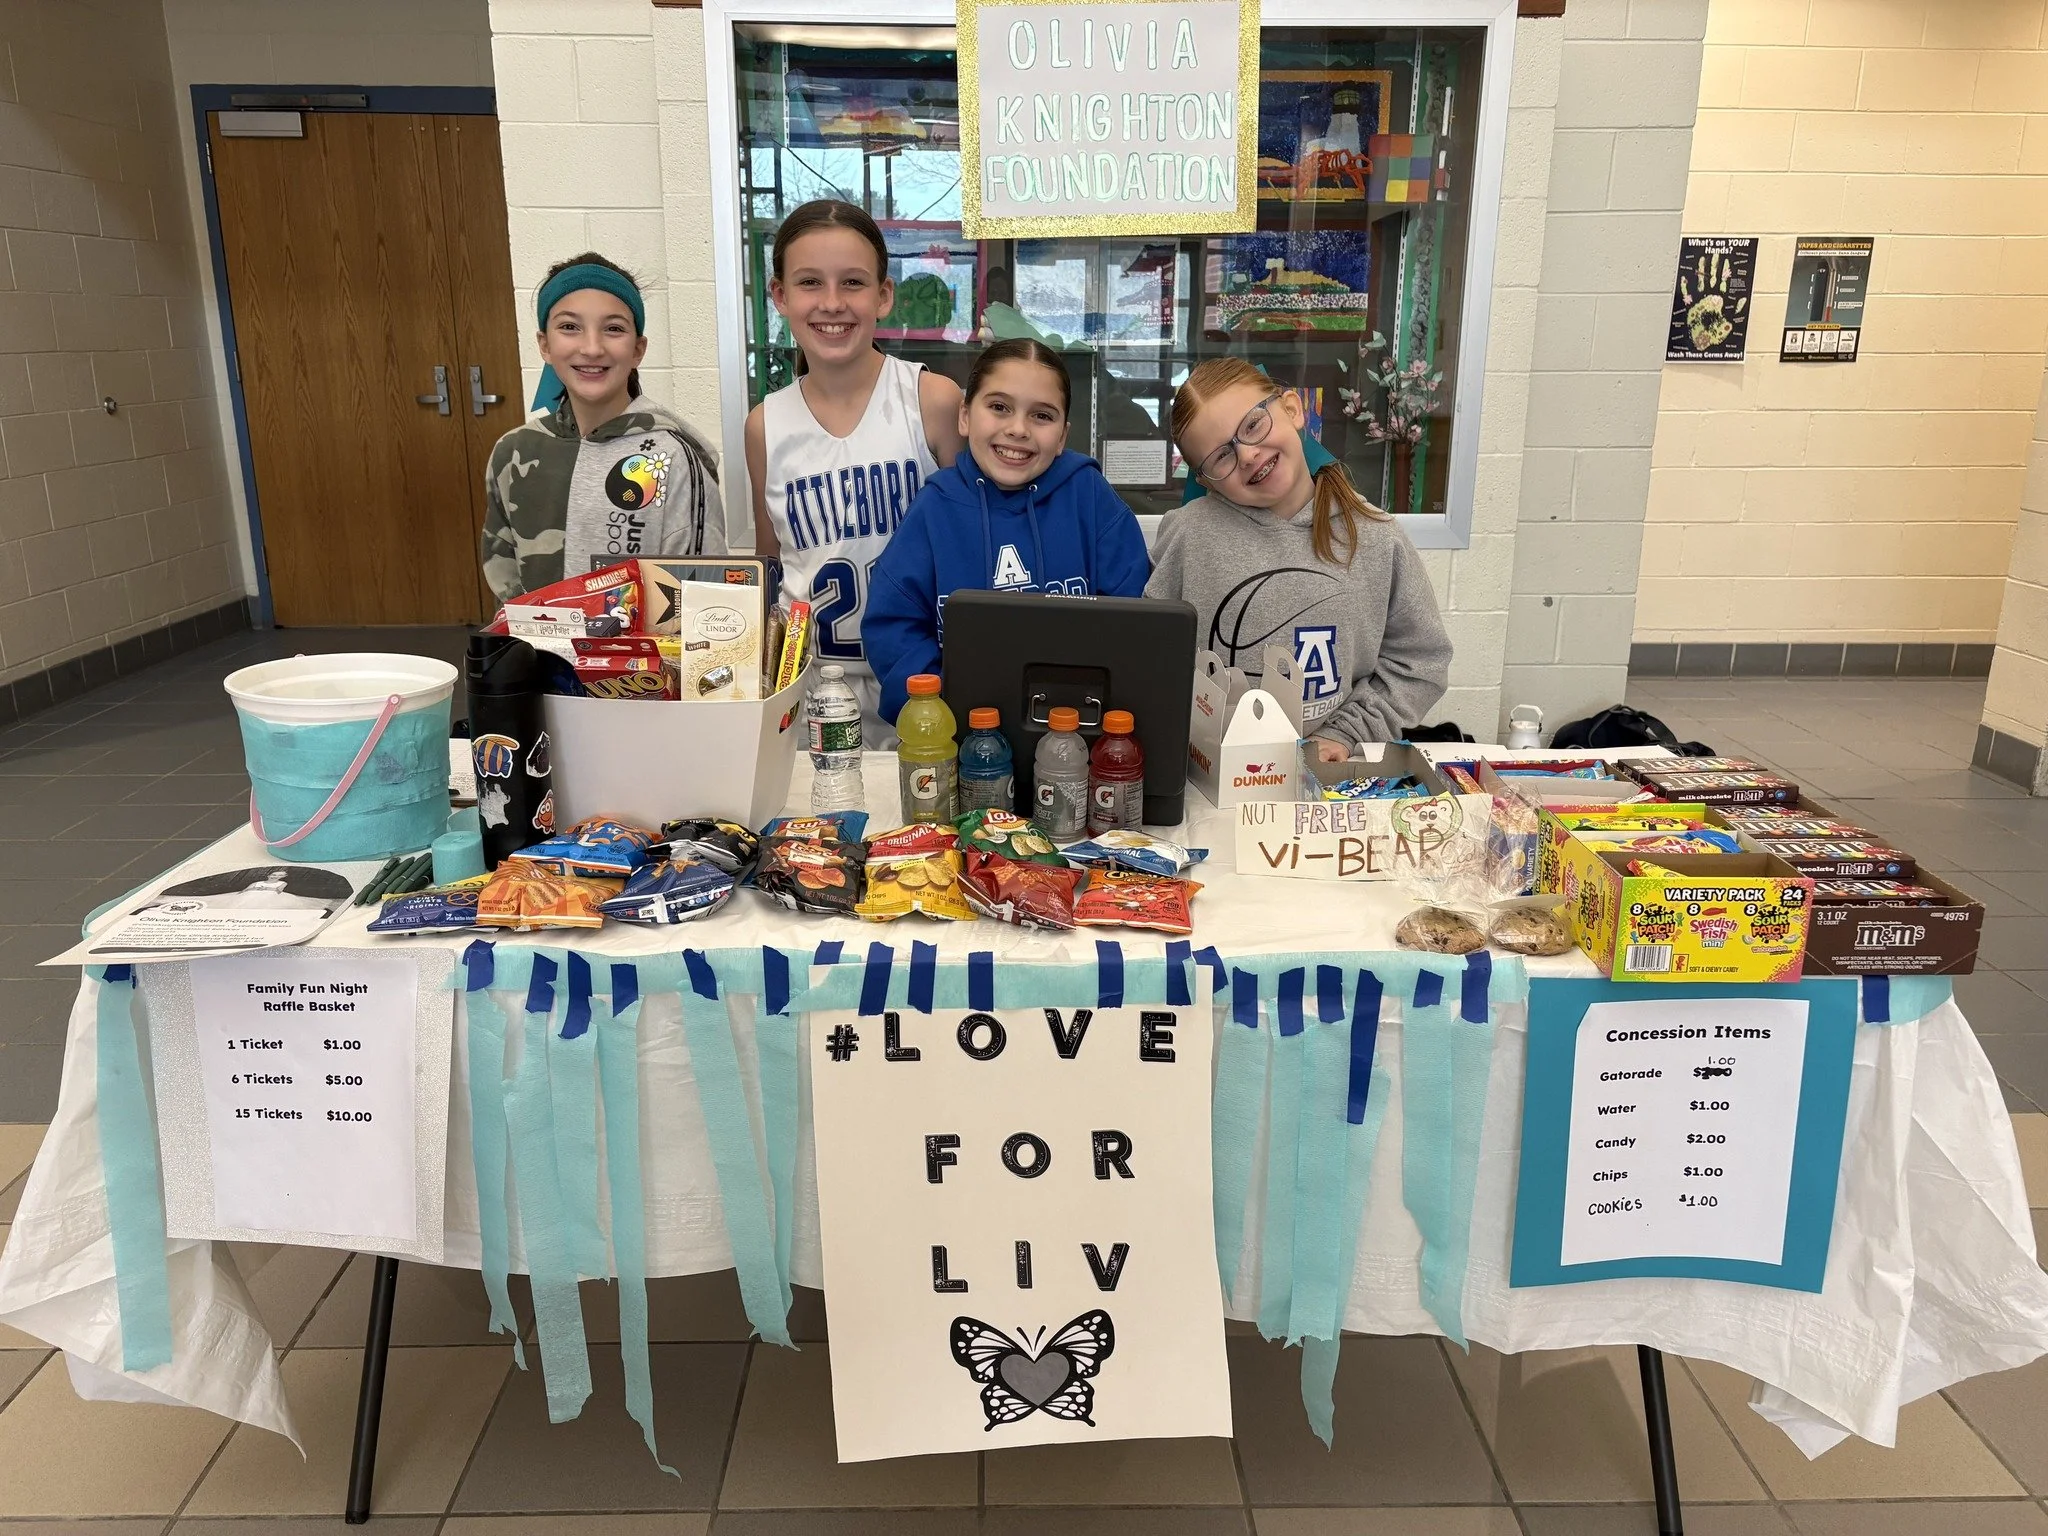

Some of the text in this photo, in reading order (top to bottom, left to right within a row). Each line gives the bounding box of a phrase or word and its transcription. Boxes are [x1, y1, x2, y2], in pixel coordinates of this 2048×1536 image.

[1008, 19, 1198, 72] OLIVIA
[997, 91, 1232, 144] KNIGHTON
[985, 152, 1236, 203] FOUNDATION
[1688, 239, 1714, 247] What's
[1728, 239, 1750, 247] YOUR
[1724, 351, 1743, 359] Away!
[993, 544, 1031, 589] A
[687, 643, 707, 651] WHITE
[1294, 625, 1342, 700] A
[585, 671, 666, 698] UNO
[1233, 774, 1287, 787] DUNKIN'
[786, 820, 828, 829] Lay's
[1242, 802, 1367, 835] NUT FREE
[887, 826, 931, 845] ORIGINAL
[1527, 847, 1535, 878] VARIETY
[1665, 888, 1764, 901] VARIETY PACK
[1783, 889, 1803, 900] 24
[1633, 905, 1641, 915] 8
[1689, 905, 1698, 915] 8
[1747, 905, 1755, 915] 8
[1817, 912, 1848, 920] 3.1 OZ
[1943, 912, 1970, 921] 49751
[173, 917, 223, 925] Knighton
[1640, 914, 1674, 925] SOUR
[1690, 918, 1738, 932] Swedish
[1754, 914, 1788, 925] SOUR
[1638, 924, 1675, 935] PATCH
[1700, 928, 1728, 940] Fish
[1752, 924, 1790, 935] PATCH
[1702, 940, 1724, 948] mini
[247, 983, 368, 996] Family Fun Night
[263, 1001, 356, 1012] Raffle Basket
[825, 1008, 1177, 1062] #LOVE
[1606, 1025, 1771, 1042] Concession Items
[227, 1038, 361, 1050] 1 Ticket $1.00
[1600, 1056, 1736, 1082] Gatorade 1.00
[231, 1073, 363, 1086] 6 Tickets $5.00
[1597, 1100, 1730, 1115] Water $1.00
[235, 1108, 372, 1122] 15 Tickets $10.00
[1595, 1133, 1726, 1149] Candy $2.00
[925, 1129, 1135, 1184] FOR
[1593, 1166, 1723, 1182] Chips $1.00
[1679, 1194, 1718, 1207] $1.00
[930, 1241, 1130, 1293] LIV
